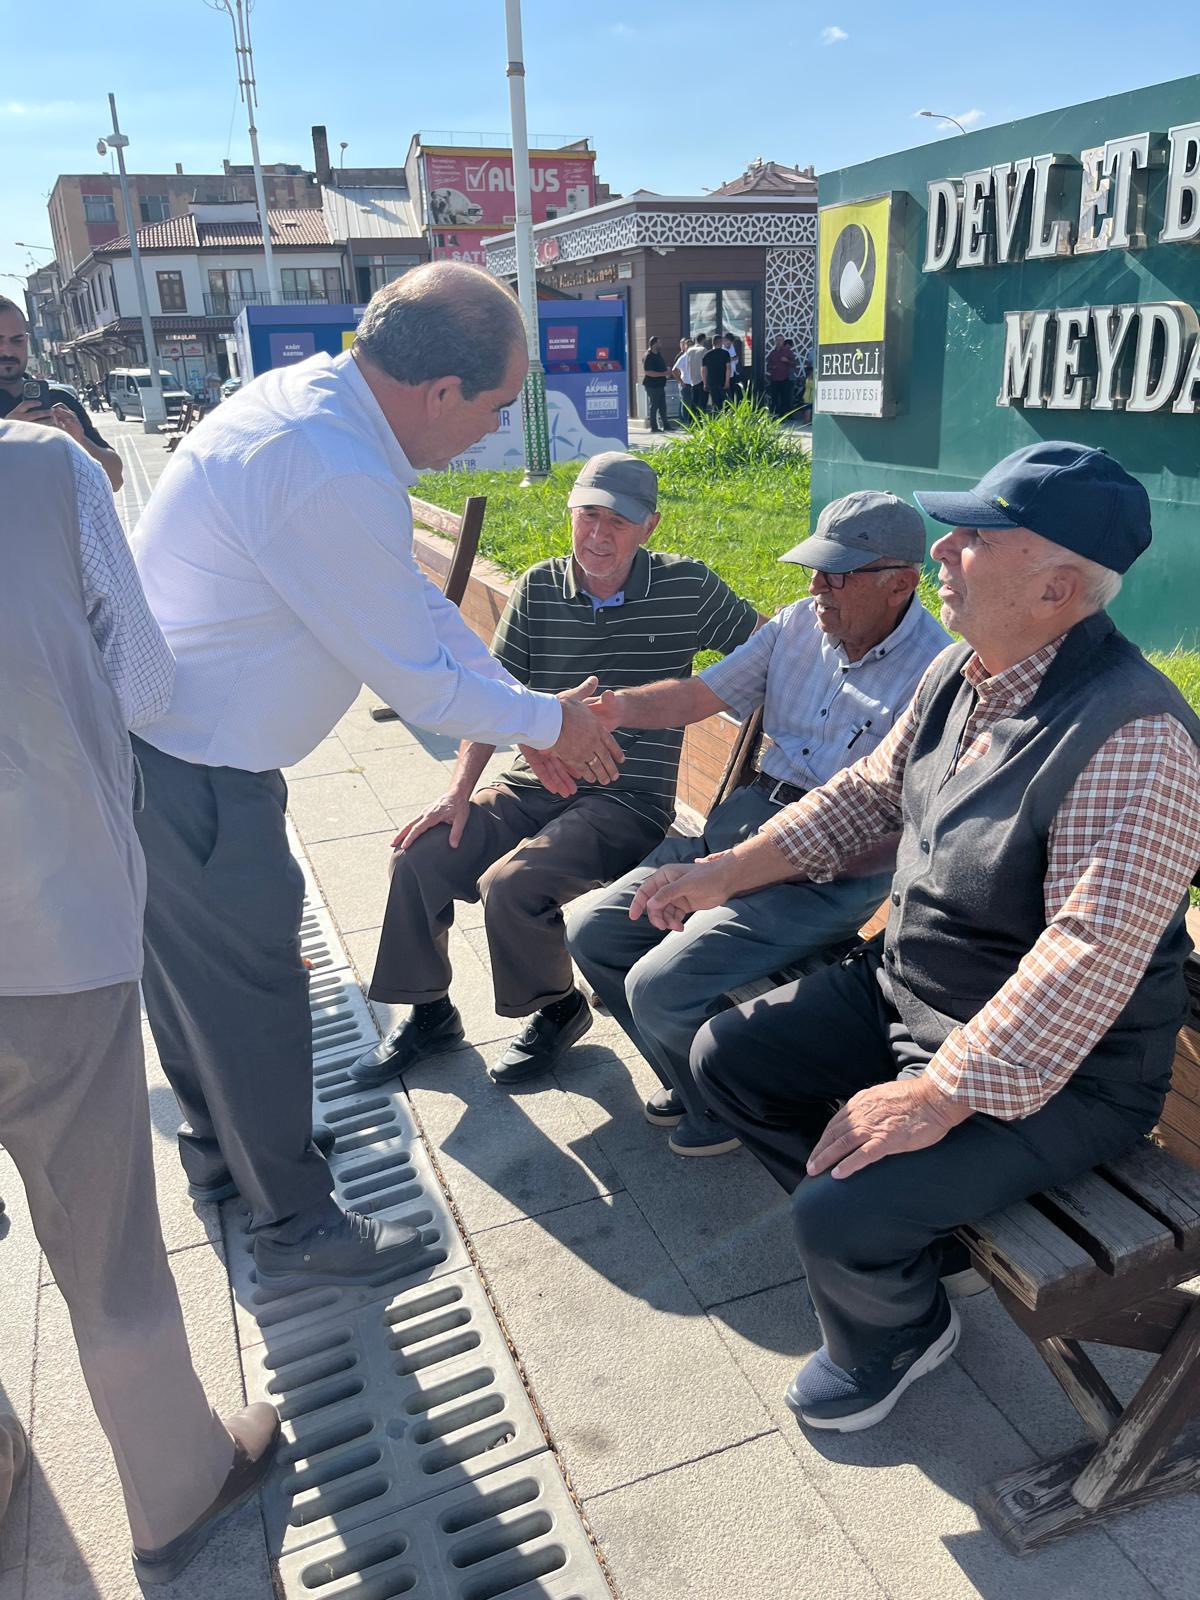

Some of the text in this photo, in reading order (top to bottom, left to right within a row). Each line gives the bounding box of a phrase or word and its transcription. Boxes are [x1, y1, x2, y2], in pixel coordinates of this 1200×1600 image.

[488, 167, 561, 193] ALUS
[921, 132, 1150, 273] DEVLET
[822, 348, 880, 376] EREĞLİ
